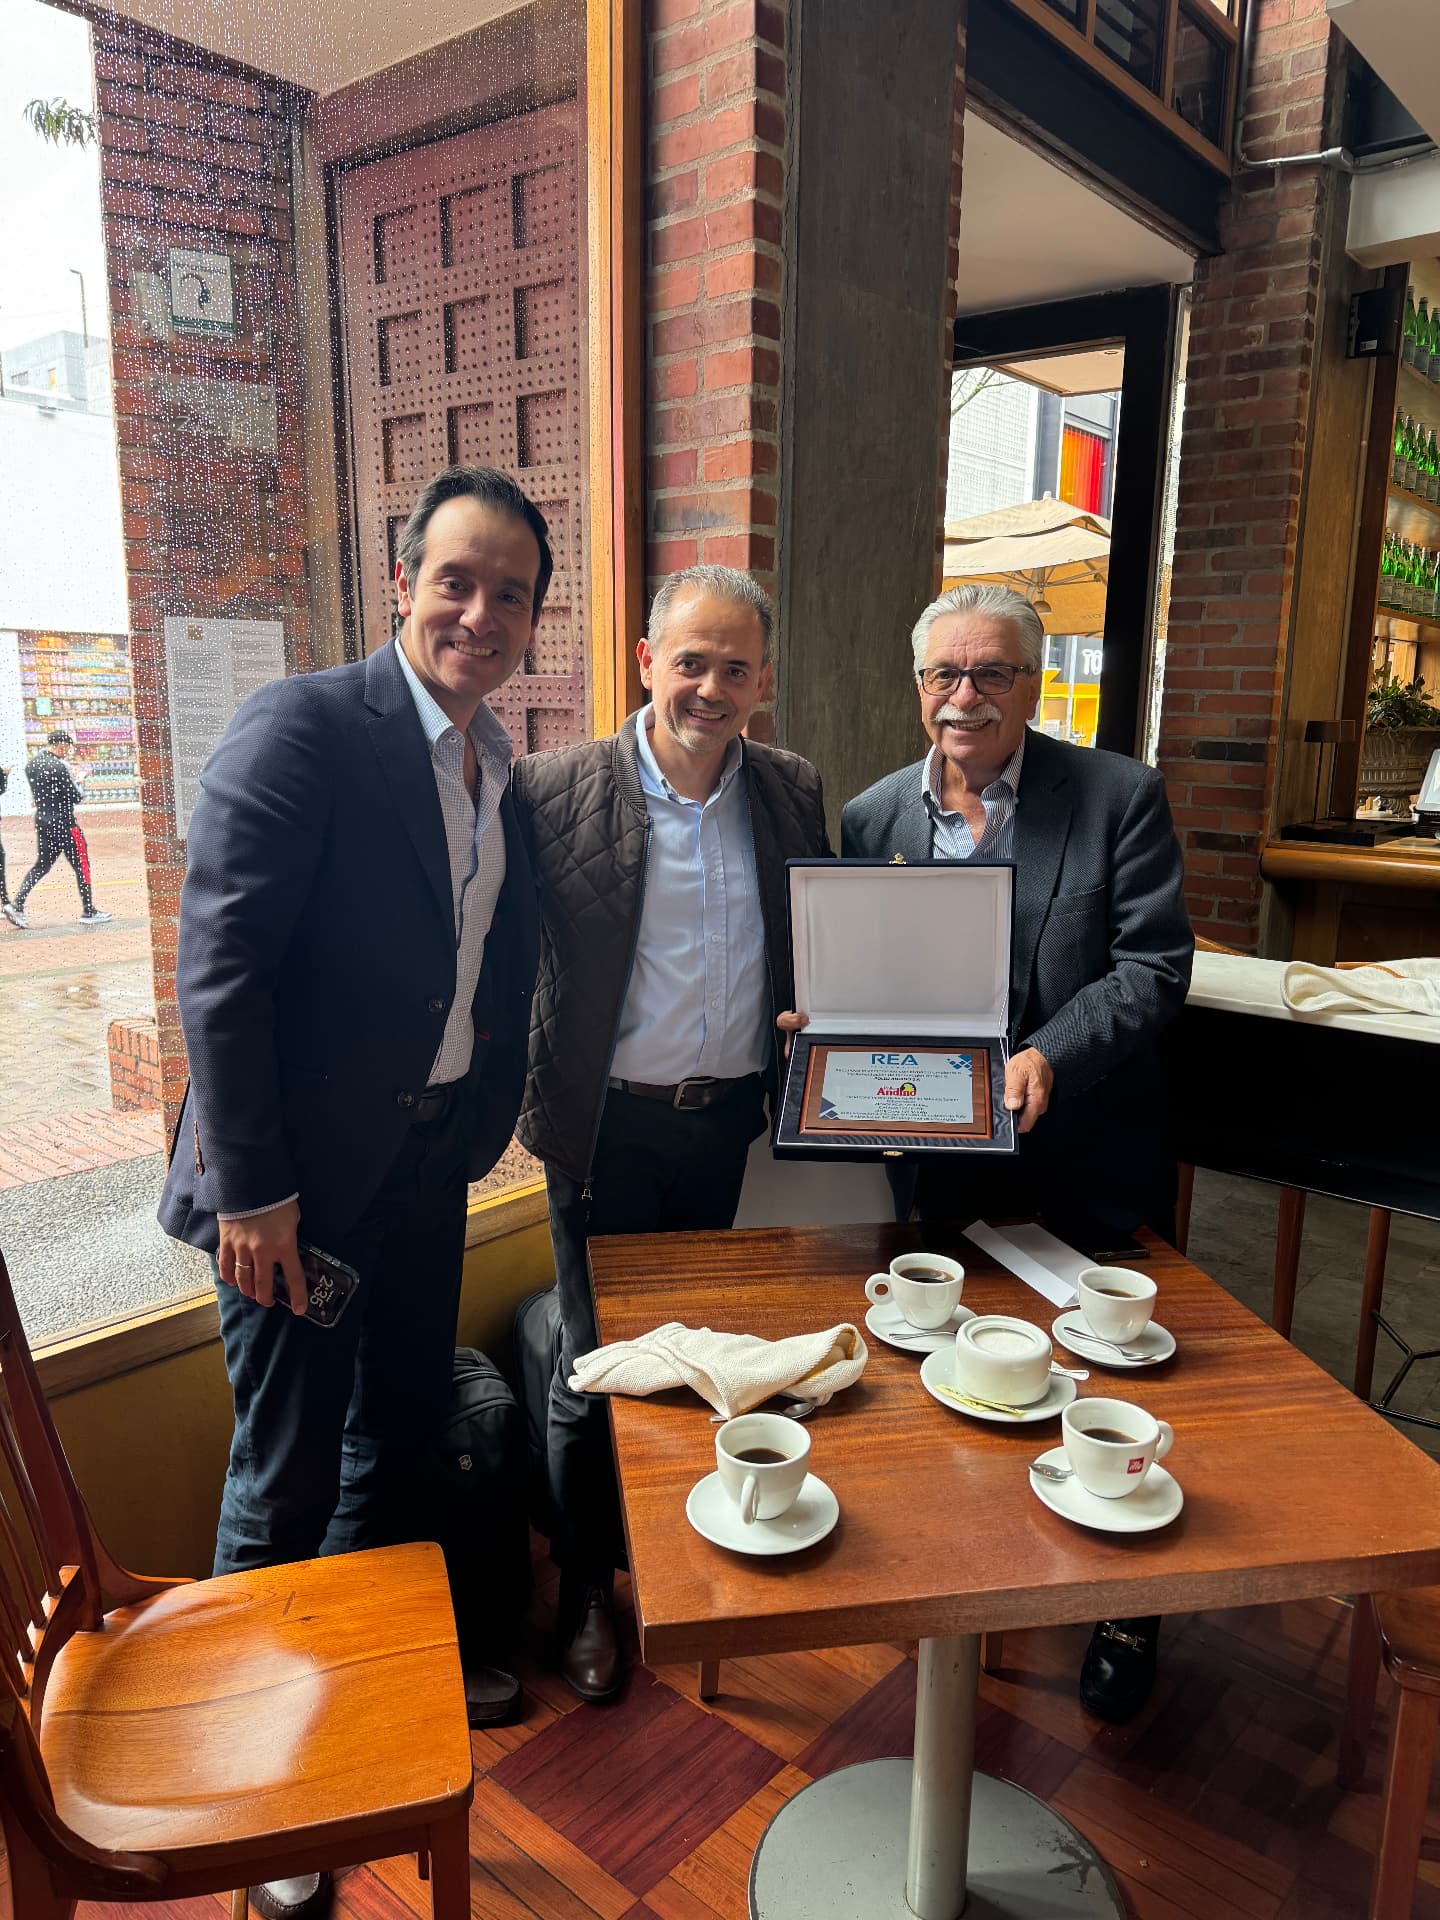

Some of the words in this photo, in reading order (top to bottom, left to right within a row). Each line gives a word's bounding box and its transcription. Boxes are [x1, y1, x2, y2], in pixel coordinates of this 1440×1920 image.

[871, 1053, 918, 1066] REA
[876, 1086, 917, 1097] Andino
[310, 1275, 334, 1308] 2:35
